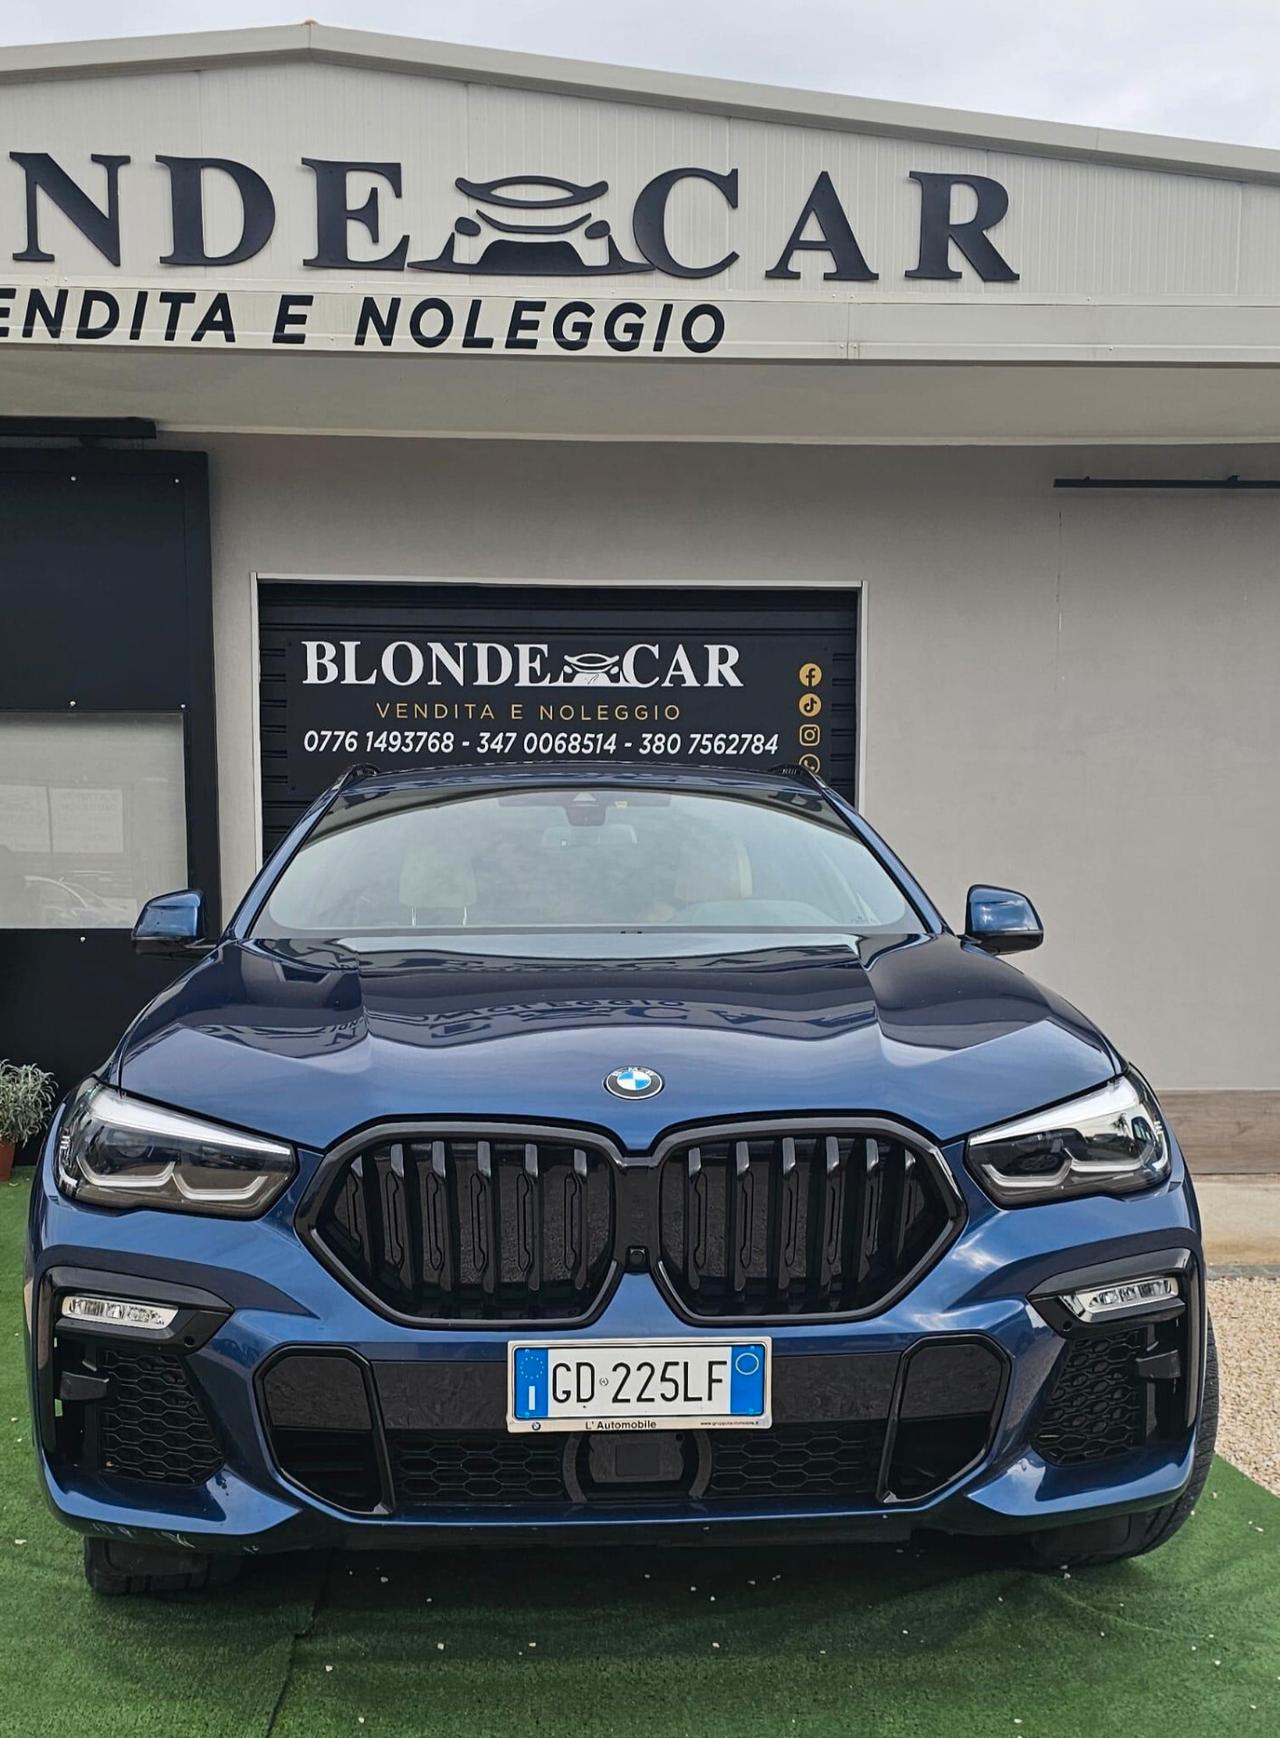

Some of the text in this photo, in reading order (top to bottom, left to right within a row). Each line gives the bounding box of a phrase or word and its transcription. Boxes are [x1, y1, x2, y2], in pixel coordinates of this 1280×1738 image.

[633, 167, 1020, 282] CAR
[272, 295, 314, 344] E
[354, 297, 725, 354] NOLEGGIO
[301, 641, 744, 688] BLONDE CAR
[376, 703, 680, 721] VENDITA E NOLEGGIO
[304, 730, 358, 752] 0776
[365, 731, 454, 754] 1493768
[476, 732, 517, 754] 347
[523, 732, 617, 755] 0068514
[639, 733, 681, 755] 380
[688, 733, 779, 755] 7562784
[552, 1361, 596, 1404] GD
[612, 1360, 728, 1404] 225LF
[597, 1420, 657, 1431] Automobile
